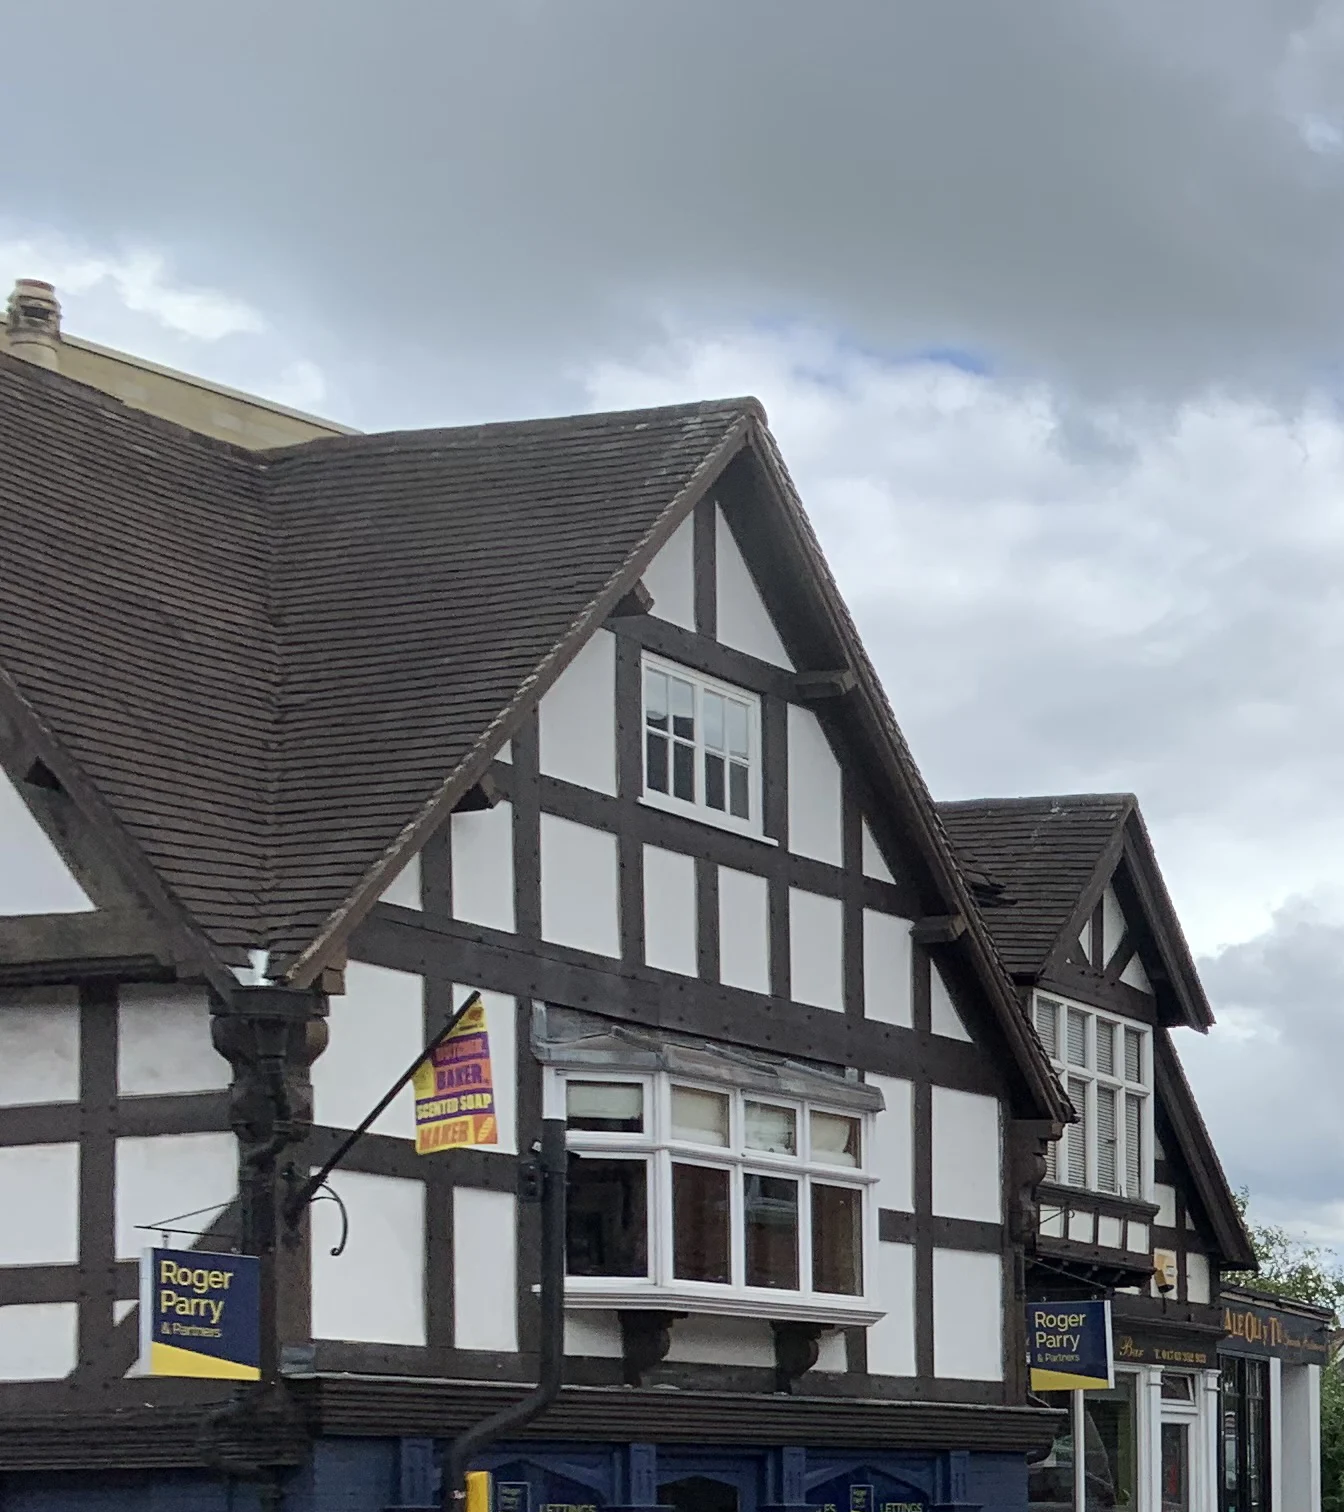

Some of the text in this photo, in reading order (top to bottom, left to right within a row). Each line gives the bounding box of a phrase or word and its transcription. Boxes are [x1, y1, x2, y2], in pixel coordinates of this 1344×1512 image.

[460, 1093, 492, 1111] SOAP
[419, 1120, 469, 1150] MAKER
[160, 1260, 234, 1294] Roger
[160, 1289, 225, 1324] Parry
[1034, 1311, 1086, 1332] Roger
[1035, 1331, 1080, 1352] Parry
[1037, 1353, 1080, 1363] & Partners
